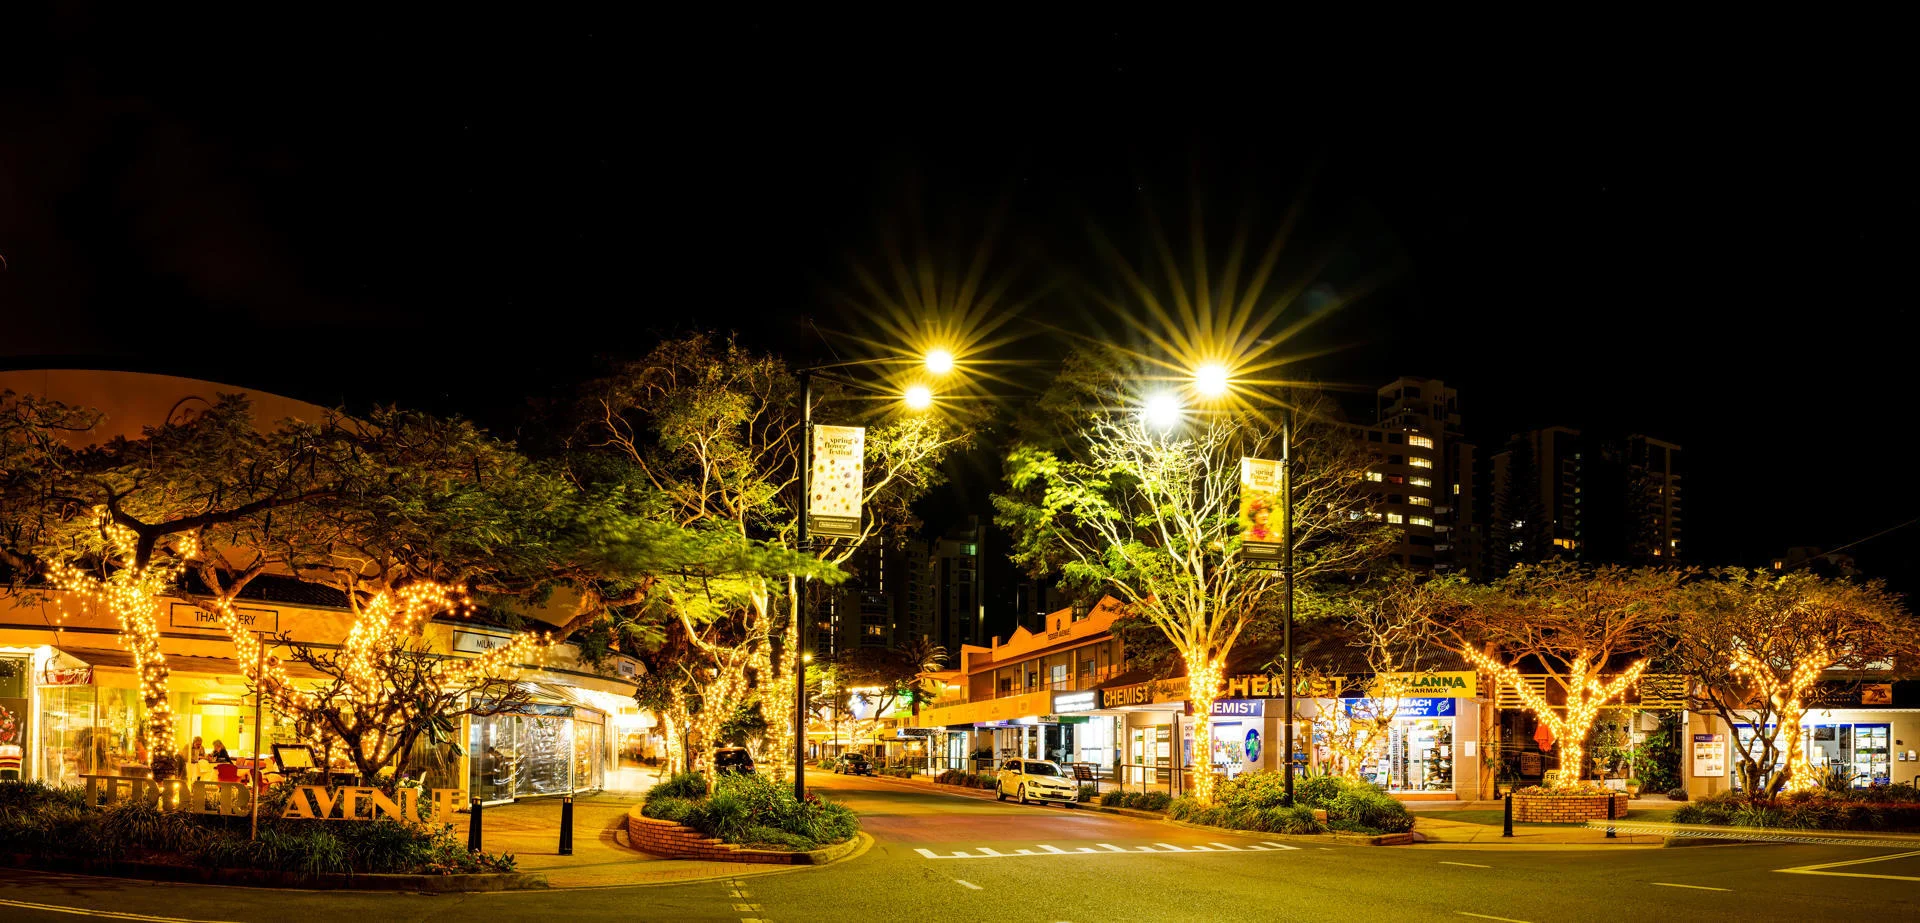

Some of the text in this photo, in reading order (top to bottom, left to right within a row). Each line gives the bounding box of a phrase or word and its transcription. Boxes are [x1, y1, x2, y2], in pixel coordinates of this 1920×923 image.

[830, 437, 853, 445] spring
[1103, 685, 1149, 707] CHEMIST
[281, 785, 468, 823] AVENUE
